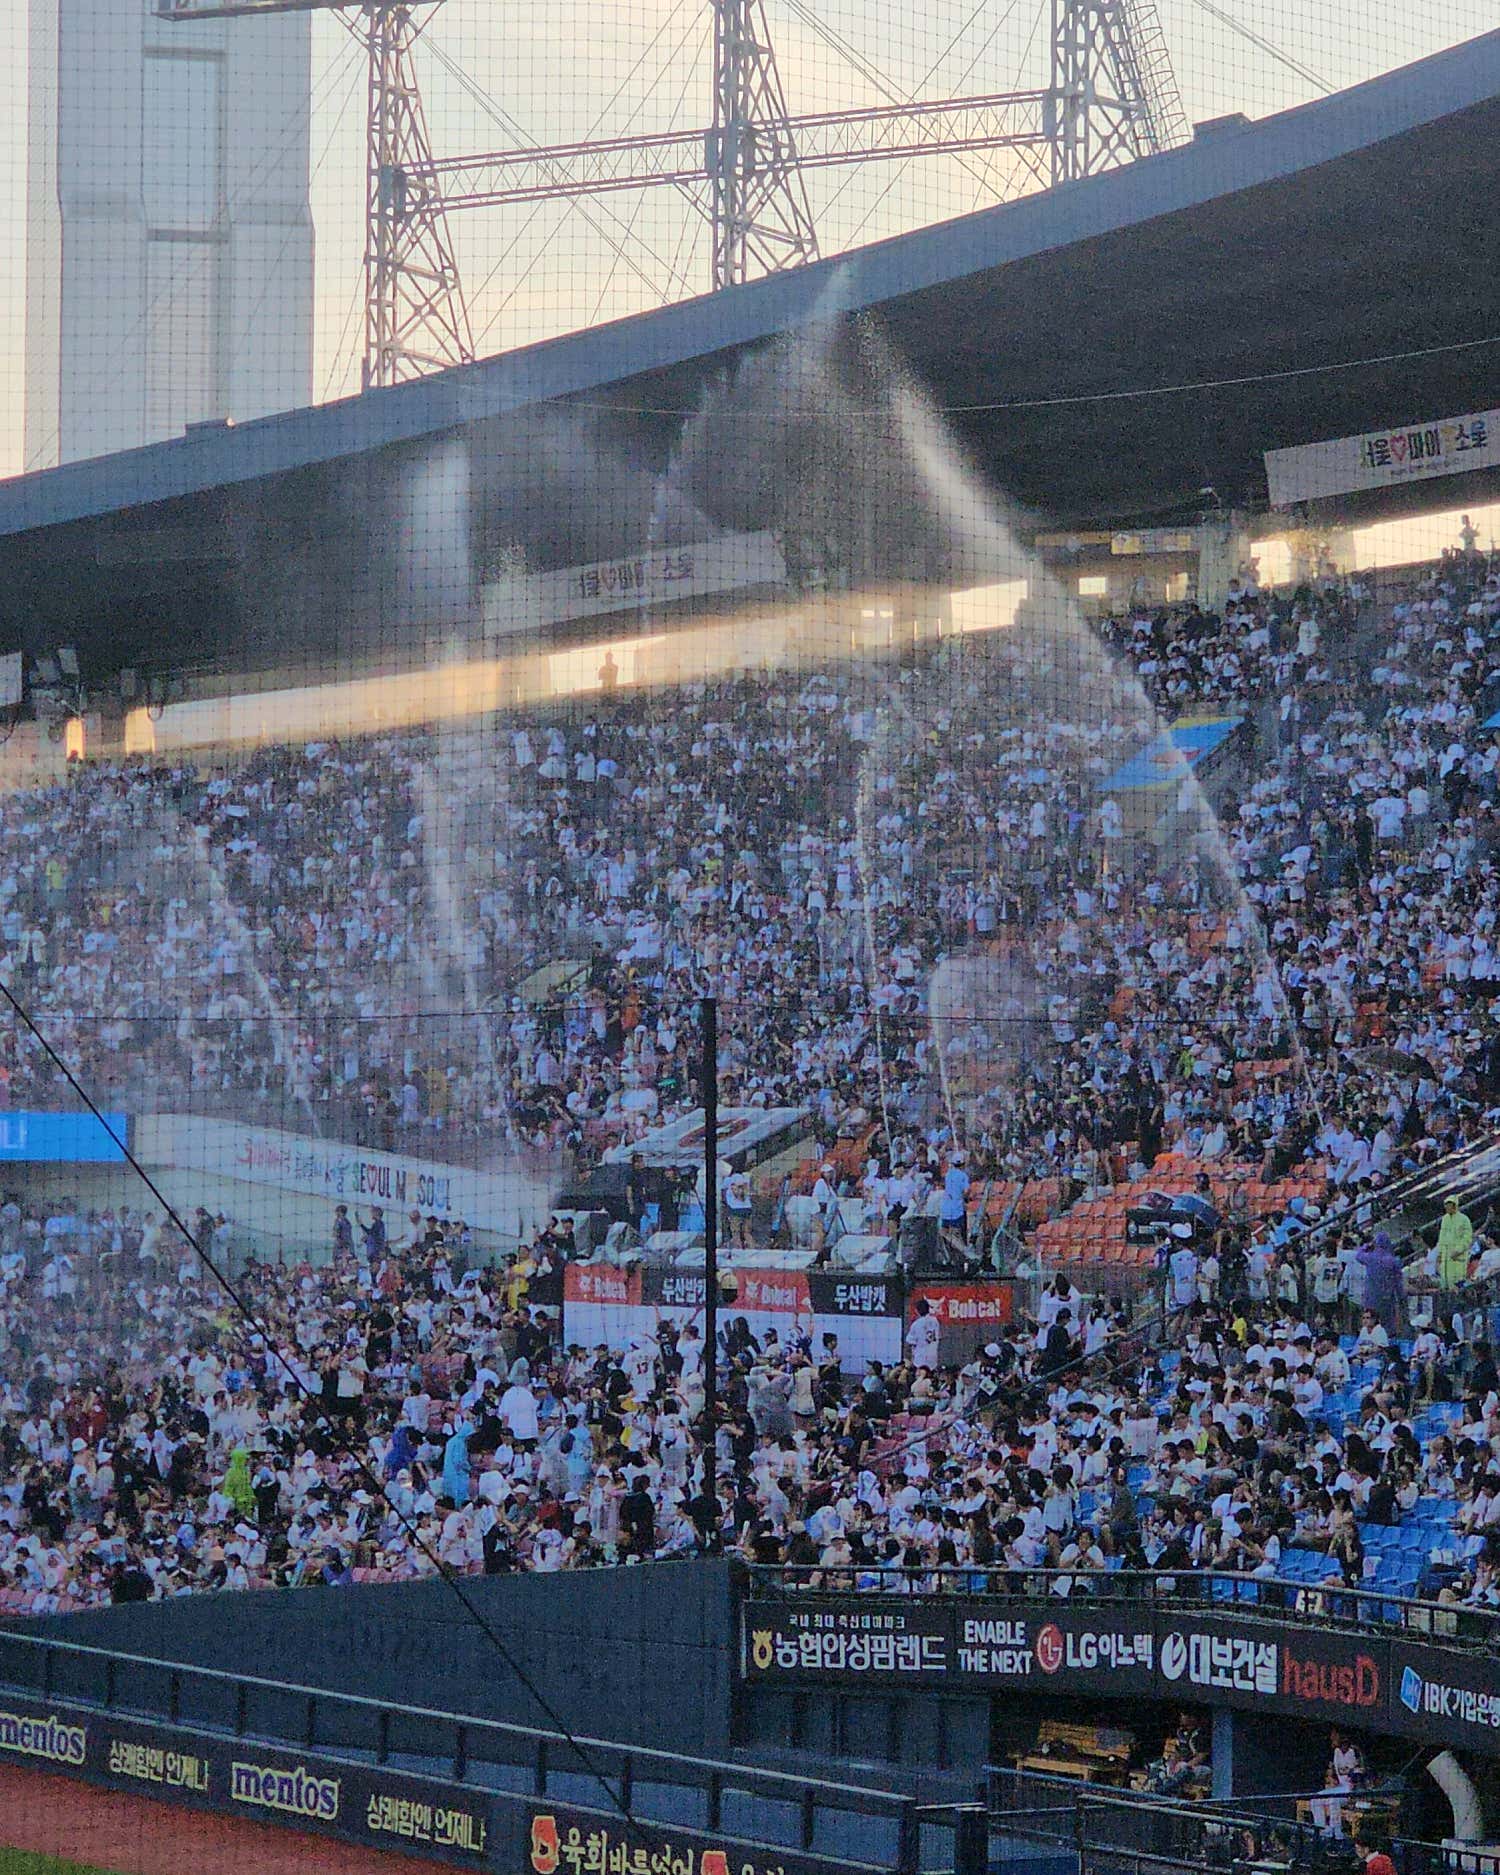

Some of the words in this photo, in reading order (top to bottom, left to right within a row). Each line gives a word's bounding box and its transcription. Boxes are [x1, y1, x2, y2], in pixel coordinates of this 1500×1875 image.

[834, 1284, 887, 1312] 두산밥캣
[948, 1298, 1001, 1319] Bobcat
[775, 1632, 947, 1671] 농협안성팜랜드
[964, 1620, 1026, 1646] ENABLE
[1066, 1632, 1153, 1670] LG이노텍
[957, 1648, 988, 1673] THE
[991, 1649, 1034, 1674] NEXT
[1189, 1633, 1278, 1695] 대보건설
[1283, 1647, 1380, 1707] hausD
[0, 1713, 85, 1763] mentos
[233, 1763, 339, 1819] mentos
[434, 1808, 488, 1852] 언제나
